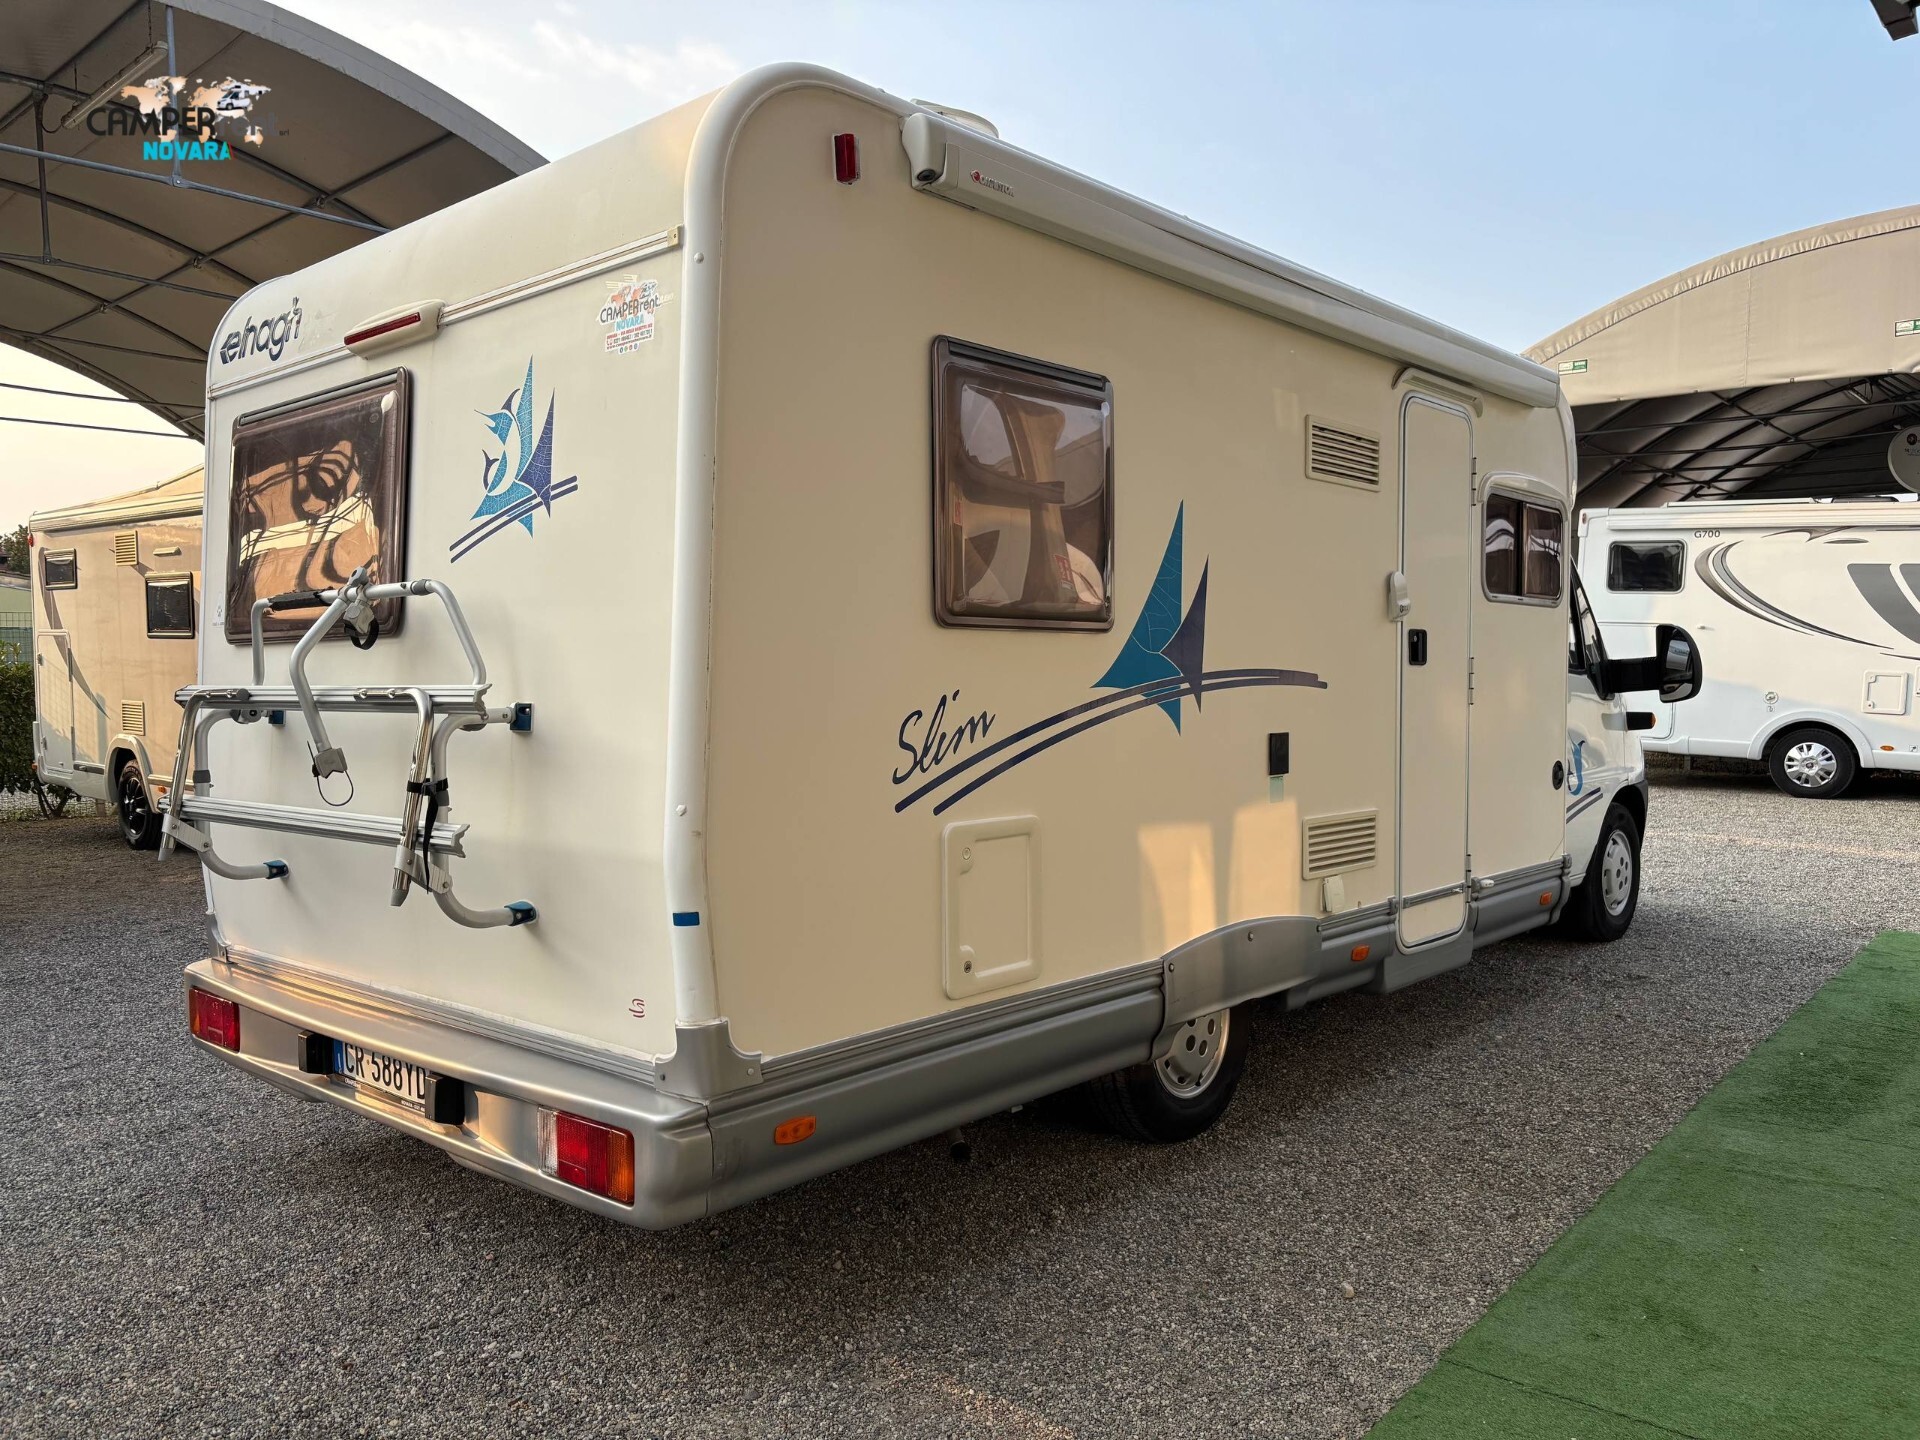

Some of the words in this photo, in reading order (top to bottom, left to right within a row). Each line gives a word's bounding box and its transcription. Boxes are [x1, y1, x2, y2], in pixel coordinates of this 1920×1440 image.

[616, 314, 644, 331] NOVARA
[1694, 530, 1721, 538] G700
[892, 689, 996, 785] Slim
